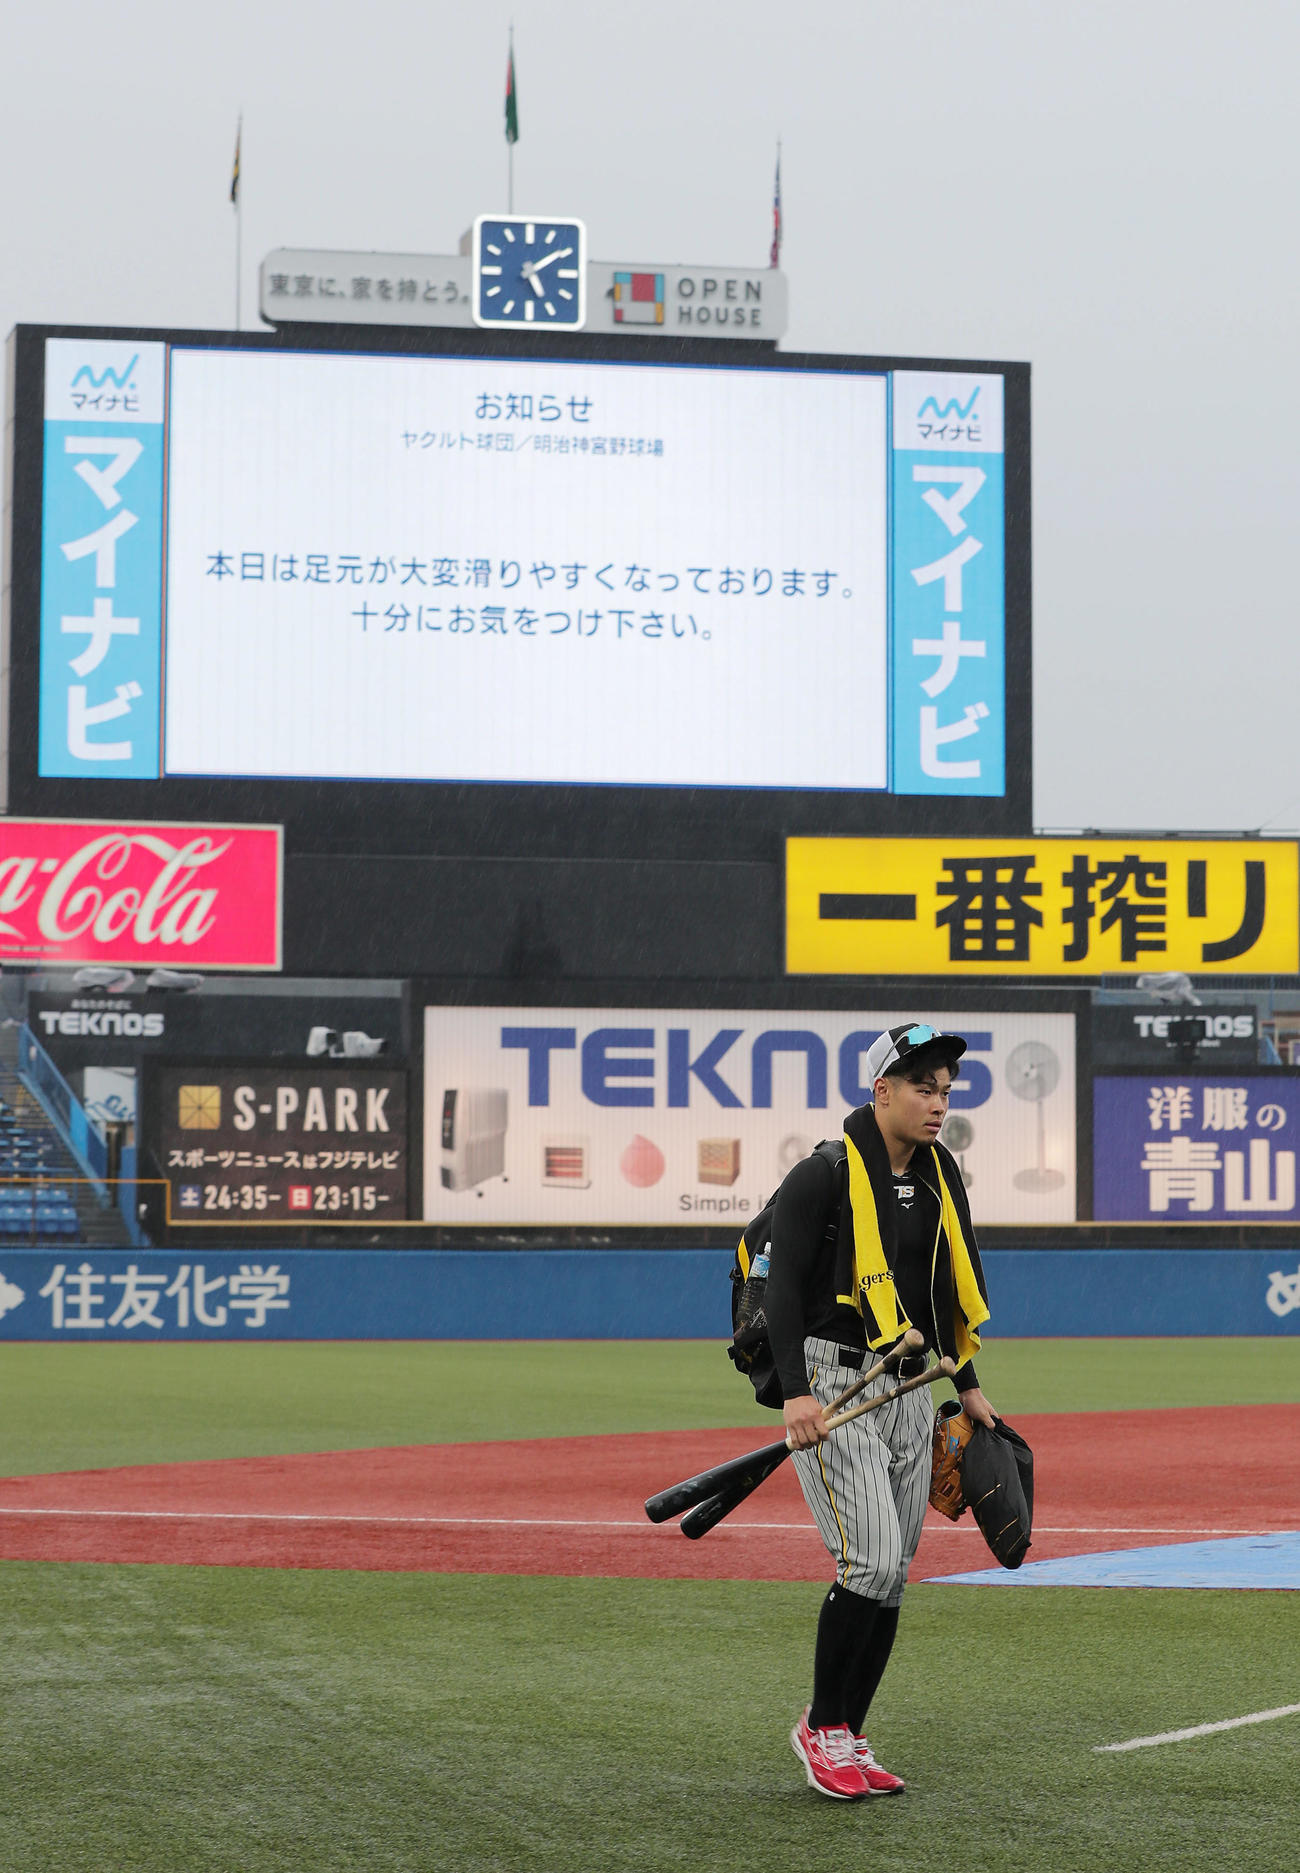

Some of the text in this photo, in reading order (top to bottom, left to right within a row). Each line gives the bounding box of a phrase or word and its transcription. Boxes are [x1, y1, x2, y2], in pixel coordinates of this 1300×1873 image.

[677, 278, 762, 301] OPEN
[677, 305, 762, 327] HOUSE
[71, 393, 140, 412] マイナビ
[475, 392, 593, 423] お知らせ
[917, 424, 982, 442] マイナビ
[205, 550, 854, 599] 本日は足元が大変滑りやすくなっております。
[60, 436, 144, 760] マイナビ
[351, 602, 714, 641] 十分にお気をつけ下さい。
[910, 465, 990, 778] マイナビ
[819, 855, 1266, 962] 一番搾り
[39, 1011, 164, 1037] TEKNOS
[233, 1086, 390, 1132] S-PARK
[1147, 1086, 1286, 1131] 洋服の
[168, 1149, 399, 1170] スポーツニュースはフジテレビ
[1141, 1136, 1295, 1212] 青山
[680, 1194, 750, 1213] Simple
[39, 1262, 290, 1329] 住友化学
[859, 1269, 894, 1291] gers
